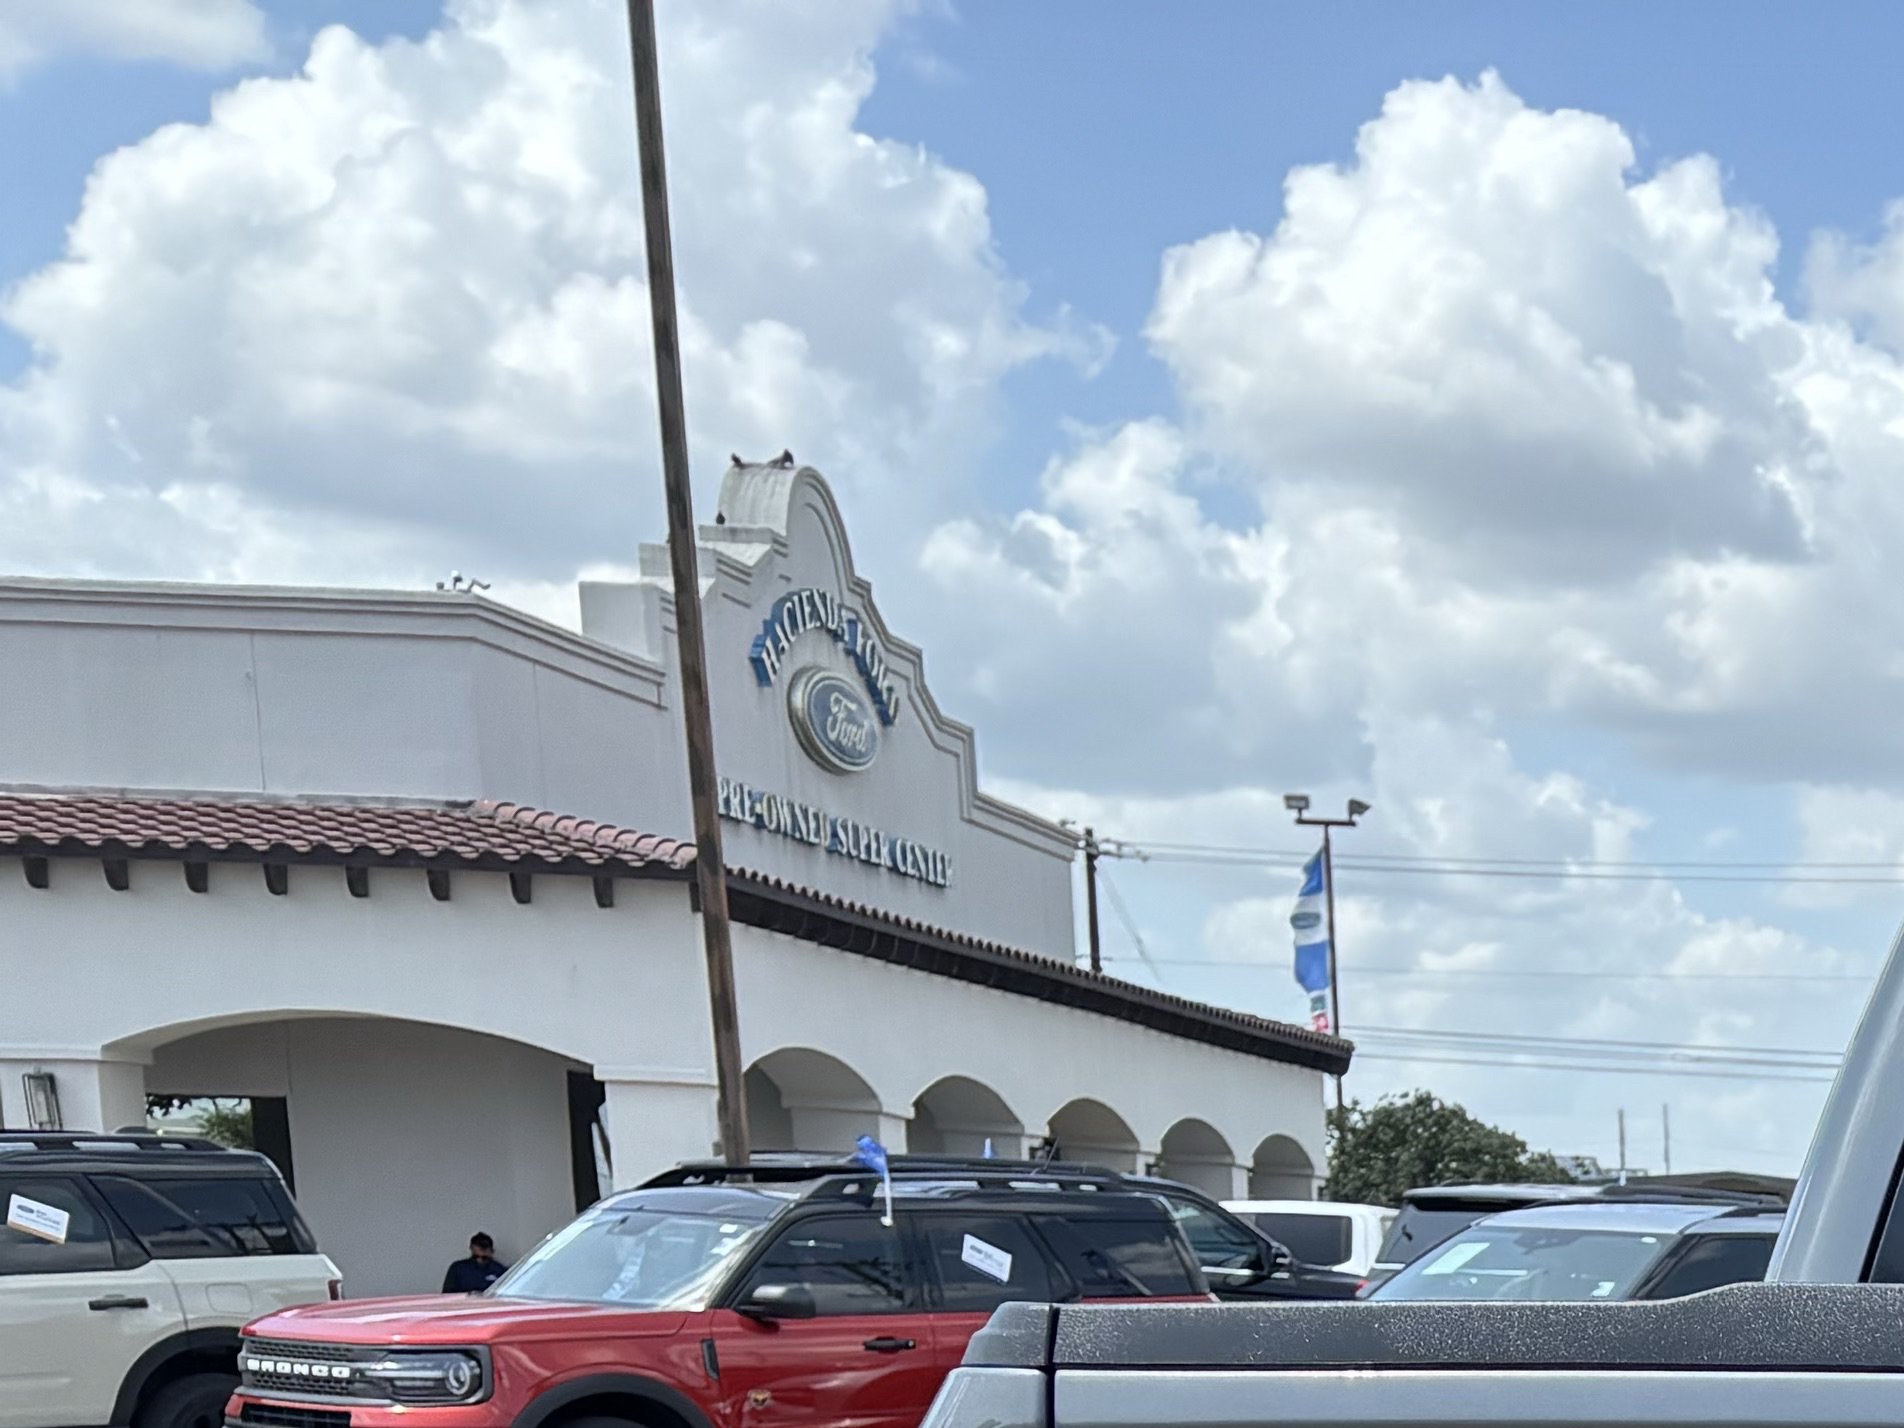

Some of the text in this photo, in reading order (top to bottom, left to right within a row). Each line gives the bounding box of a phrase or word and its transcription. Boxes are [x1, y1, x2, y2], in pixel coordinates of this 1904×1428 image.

[825, 690, 870, 754] Ford
[718, 778, 832, 846] PRE-OWNED
[836, 816, 893, 868] SUPER
[246, 1358, 351, 1379] BRONCO
